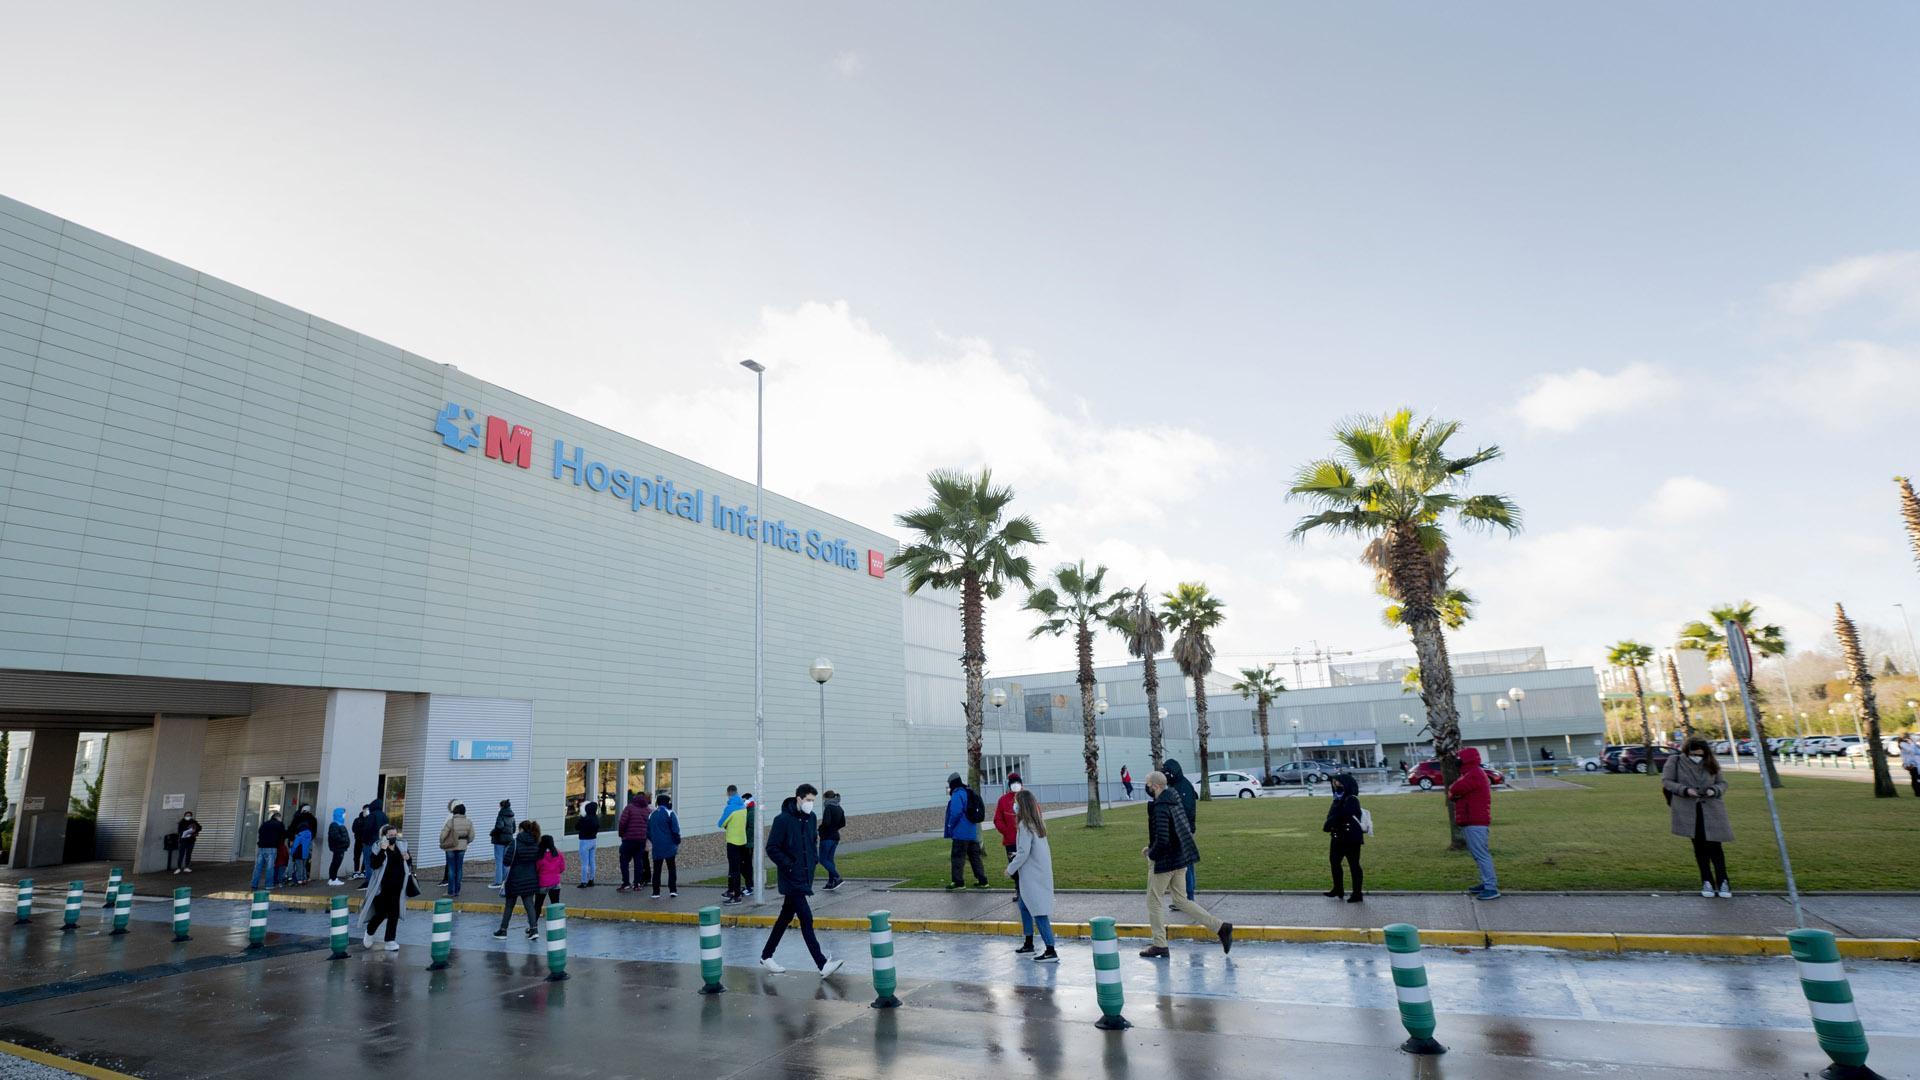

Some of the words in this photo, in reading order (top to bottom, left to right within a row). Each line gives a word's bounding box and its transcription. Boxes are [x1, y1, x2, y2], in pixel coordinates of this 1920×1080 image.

[485, 415, 532, 469] M
[553, 439, 703, 523] Hospital
[712, 494, 801, 553] Infanta
